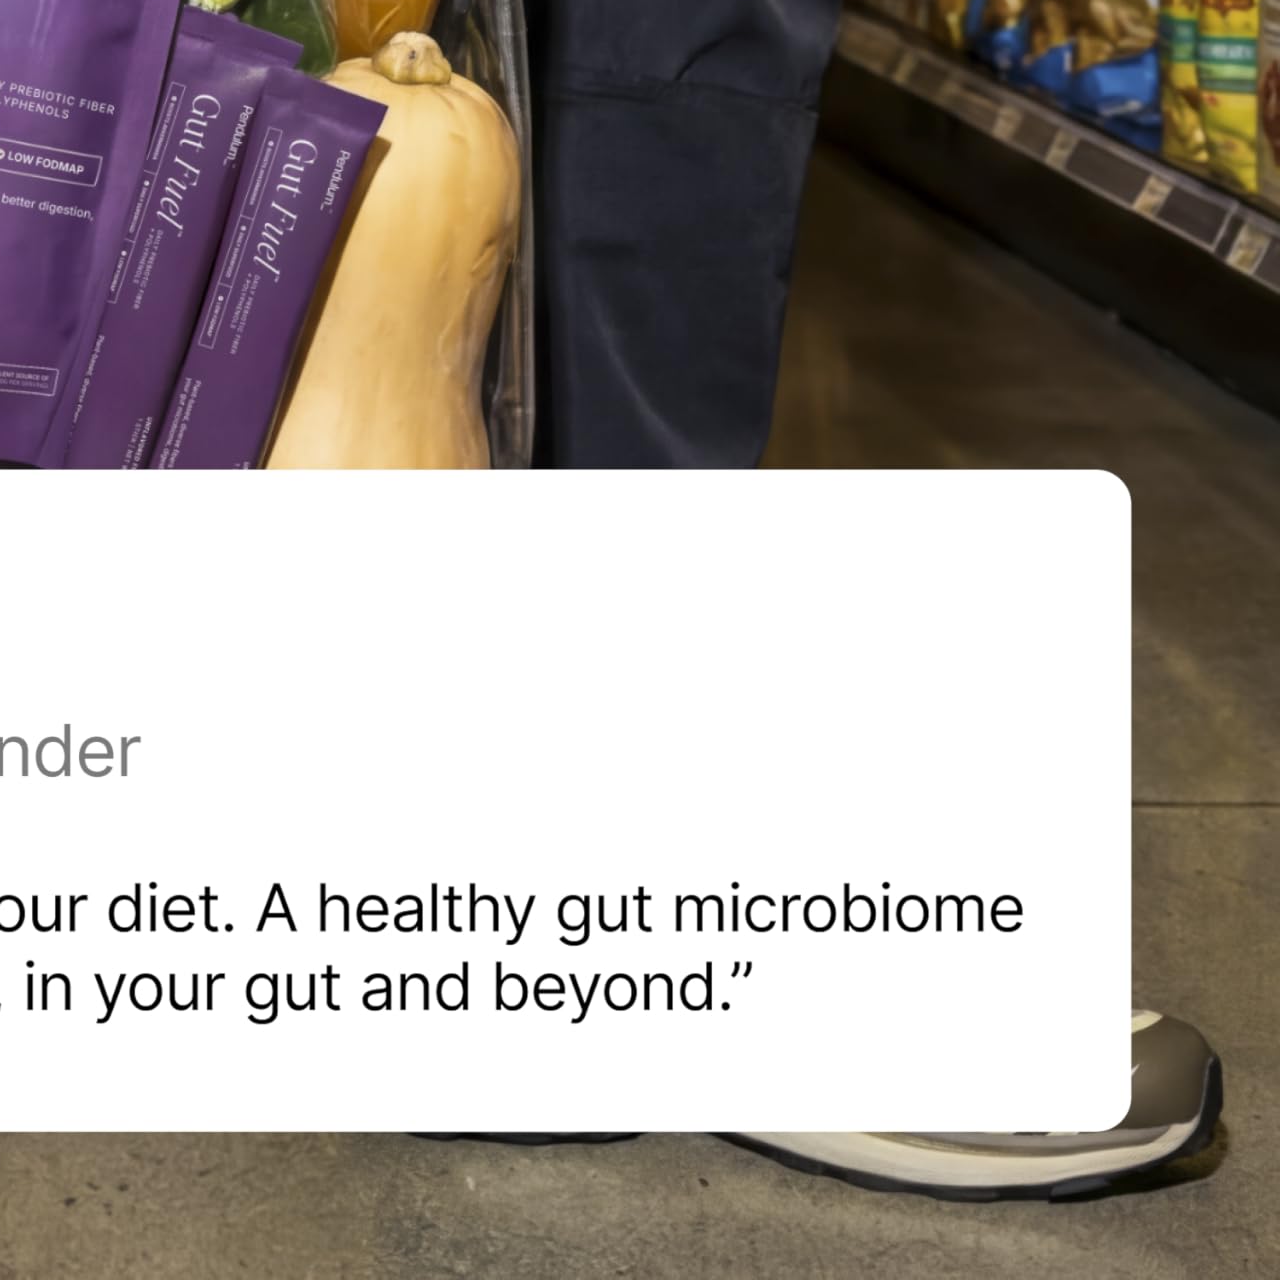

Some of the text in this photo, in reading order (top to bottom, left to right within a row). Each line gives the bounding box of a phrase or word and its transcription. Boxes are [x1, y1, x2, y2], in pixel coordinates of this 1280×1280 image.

[9, 82, 76, 107] PREBIOTIC
[78, 97, 116, 116] FIBER
[179, 93, 221, 151] Gut
[7, 151, 85, 175] LOW FODMAP
[276, 138, 318, 198] Gut
[0, 192, 36, 209] better
[38, 200, 94, 222] digestion,
